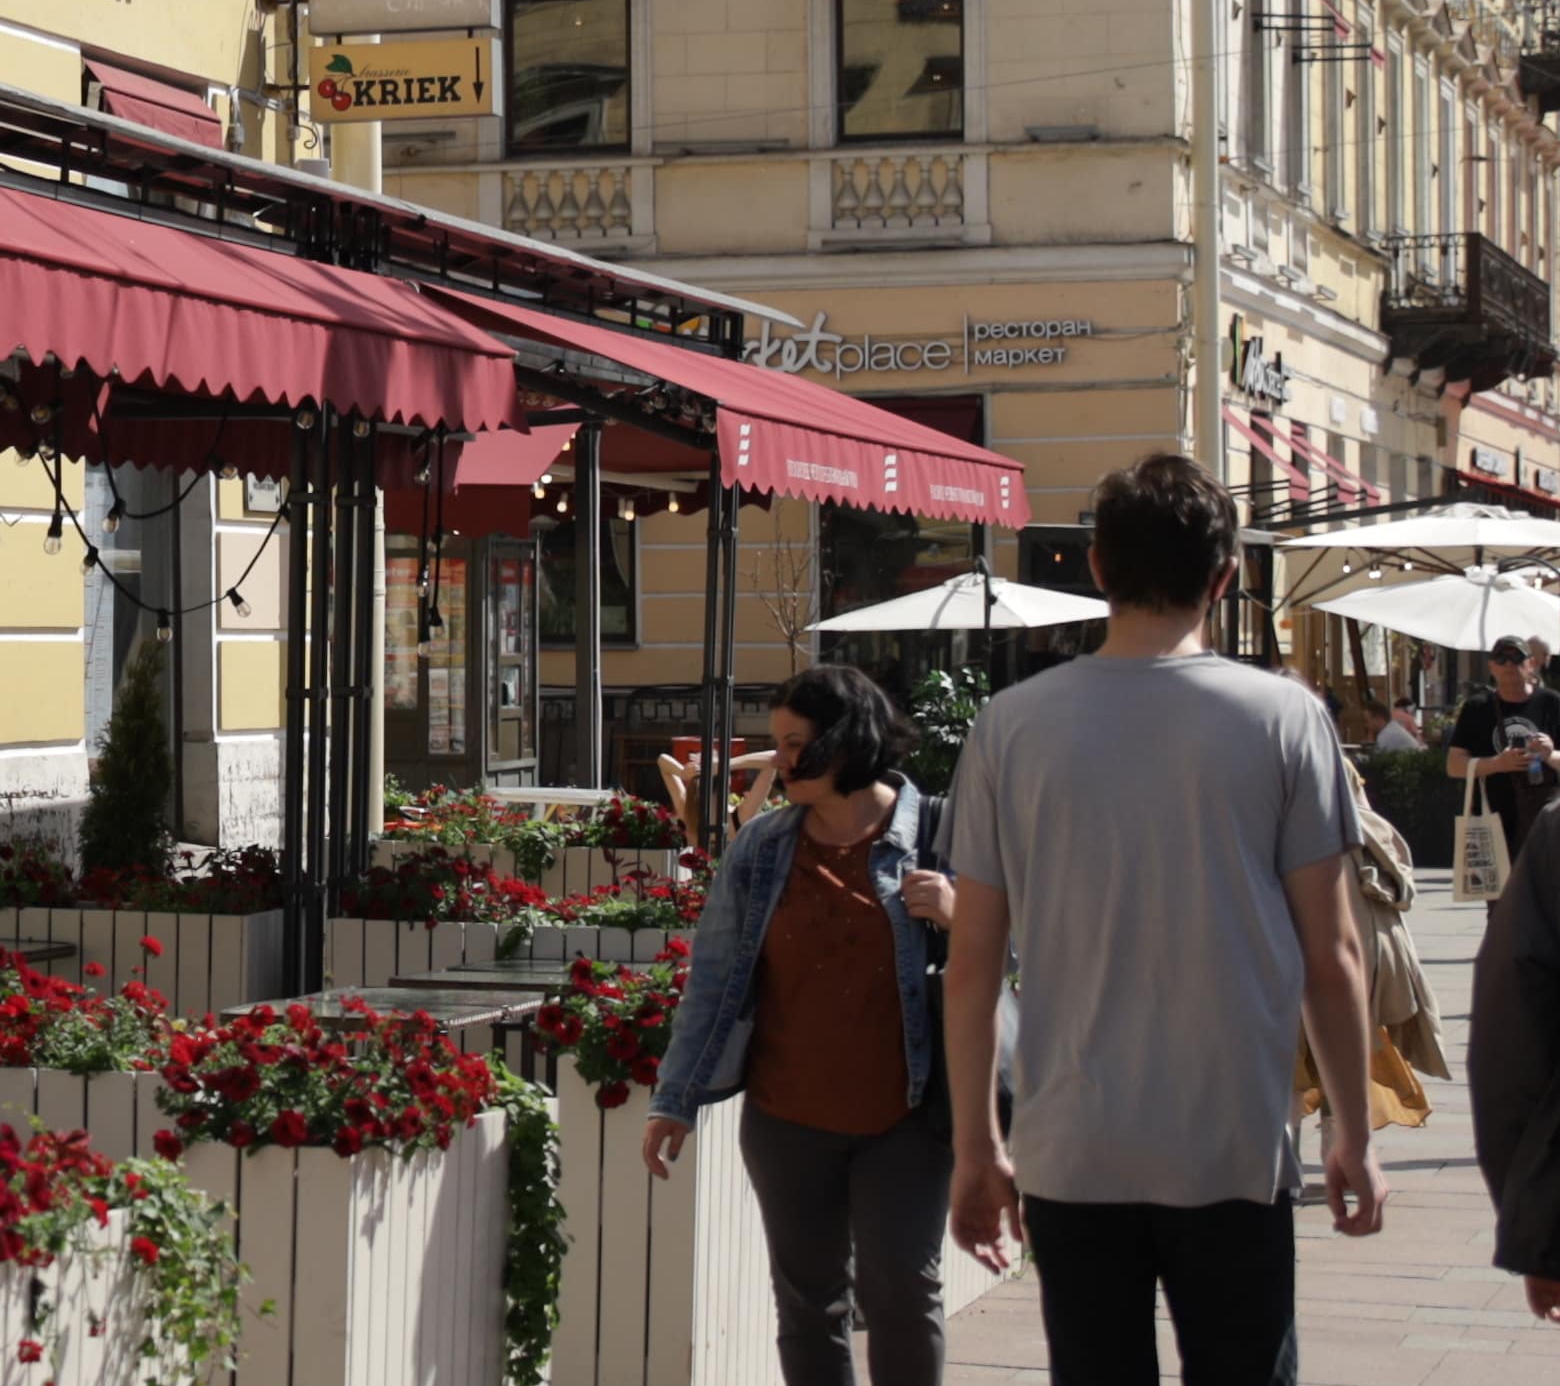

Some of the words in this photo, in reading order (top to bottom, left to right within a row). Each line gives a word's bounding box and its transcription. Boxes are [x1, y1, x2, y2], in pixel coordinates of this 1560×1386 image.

[352, 75, 461, 107] KRIEK
[974, 317, 1092, 341] ресторан
[974, 346, 1066, 368] маркет
